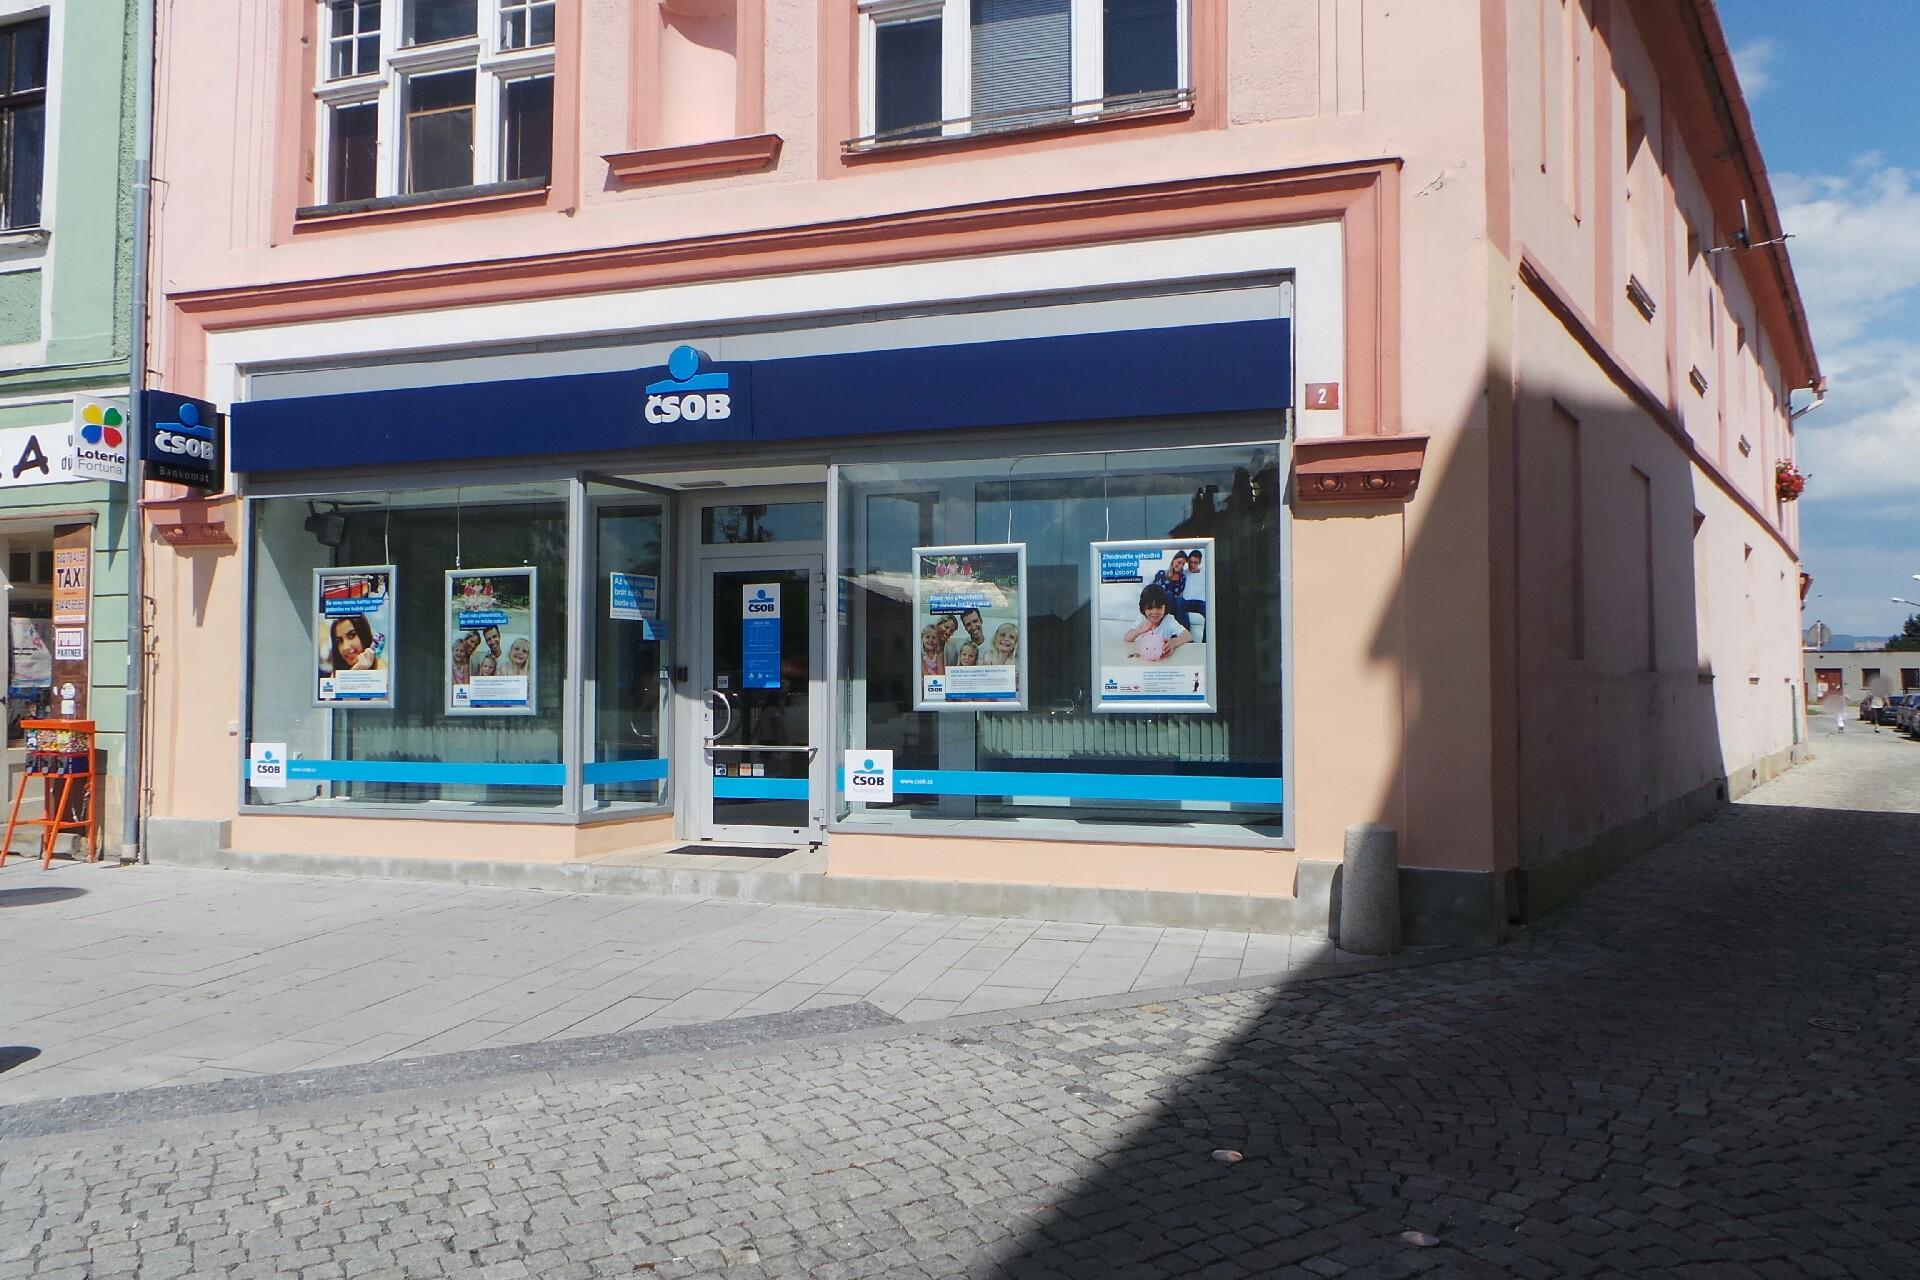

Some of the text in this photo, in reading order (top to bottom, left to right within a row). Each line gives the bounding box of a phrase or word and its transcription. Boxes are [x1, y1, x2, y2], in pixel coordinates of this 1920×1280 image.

[1318, 388, 1327, 404] 2
[645, 394, 731, 424] ČSOB
[154, 430, 214, 460] ČSOB
[77, 447, 126, 464] Loterie
[78, 458, 123, 475] Fortuna
[160, 466, 209, 483] Bankomat
[748, 603, 775, 612] ČSOB
[57, 648, 81, 658] PARTNER
[257, 764, 281, 774] ČSOB
[852, 774, 885, 786] ČSOB
